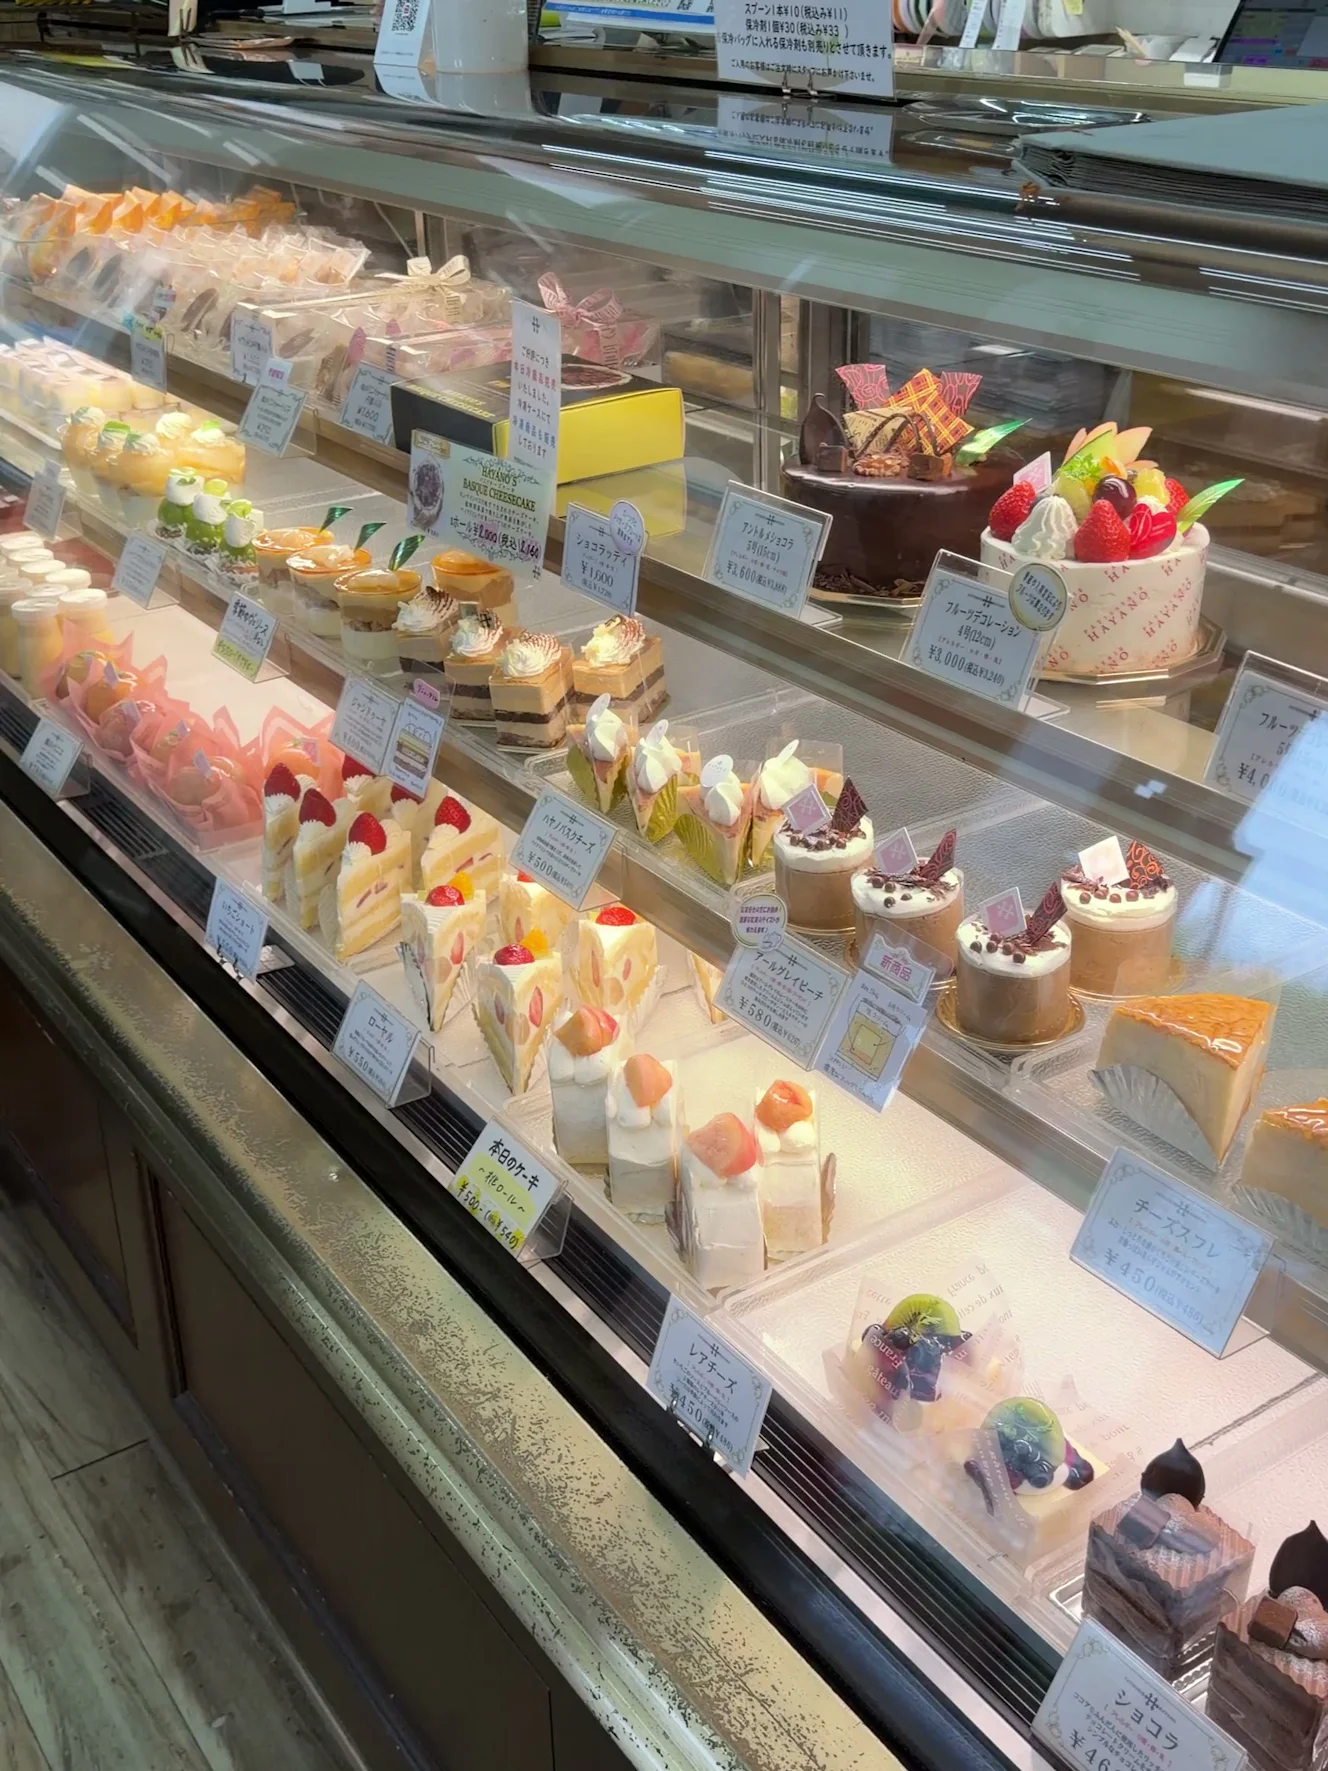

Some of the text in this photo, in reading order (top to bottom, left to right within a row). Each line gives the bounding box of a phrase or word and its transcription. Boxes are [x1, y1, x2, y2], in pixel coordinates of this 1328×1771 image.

[481, 465, 518, 487] HAYANO'S
[463, 478, 536, 512] BASQUE CHEESECAKE
[742, 522, 794, 550] アントルメショコラ
[581, 560, 614, 587] ¥1,600
[945, 601, 1021, 638] フルーツデコレーション
[1087, 591, 1148, 642] HAYANO
[1145, 580, 1192, 638] HAYANO
[957, 624, 997, 651] 4号(12cm)
[542, 814, 597, 854] ハヤノバスクチーズ
[879, 954, 913, 982] 新商品
[368, 1015, 393, 1043] ローヤル
[488, 1137, 540, 1192] 本日のケーキ
[1133, 1198, 1220, 1259] チーズスフレ
[688, 1341, 736, 1396] レアチーズ
[1114, 1689, 1179, 1751] ショコラ
